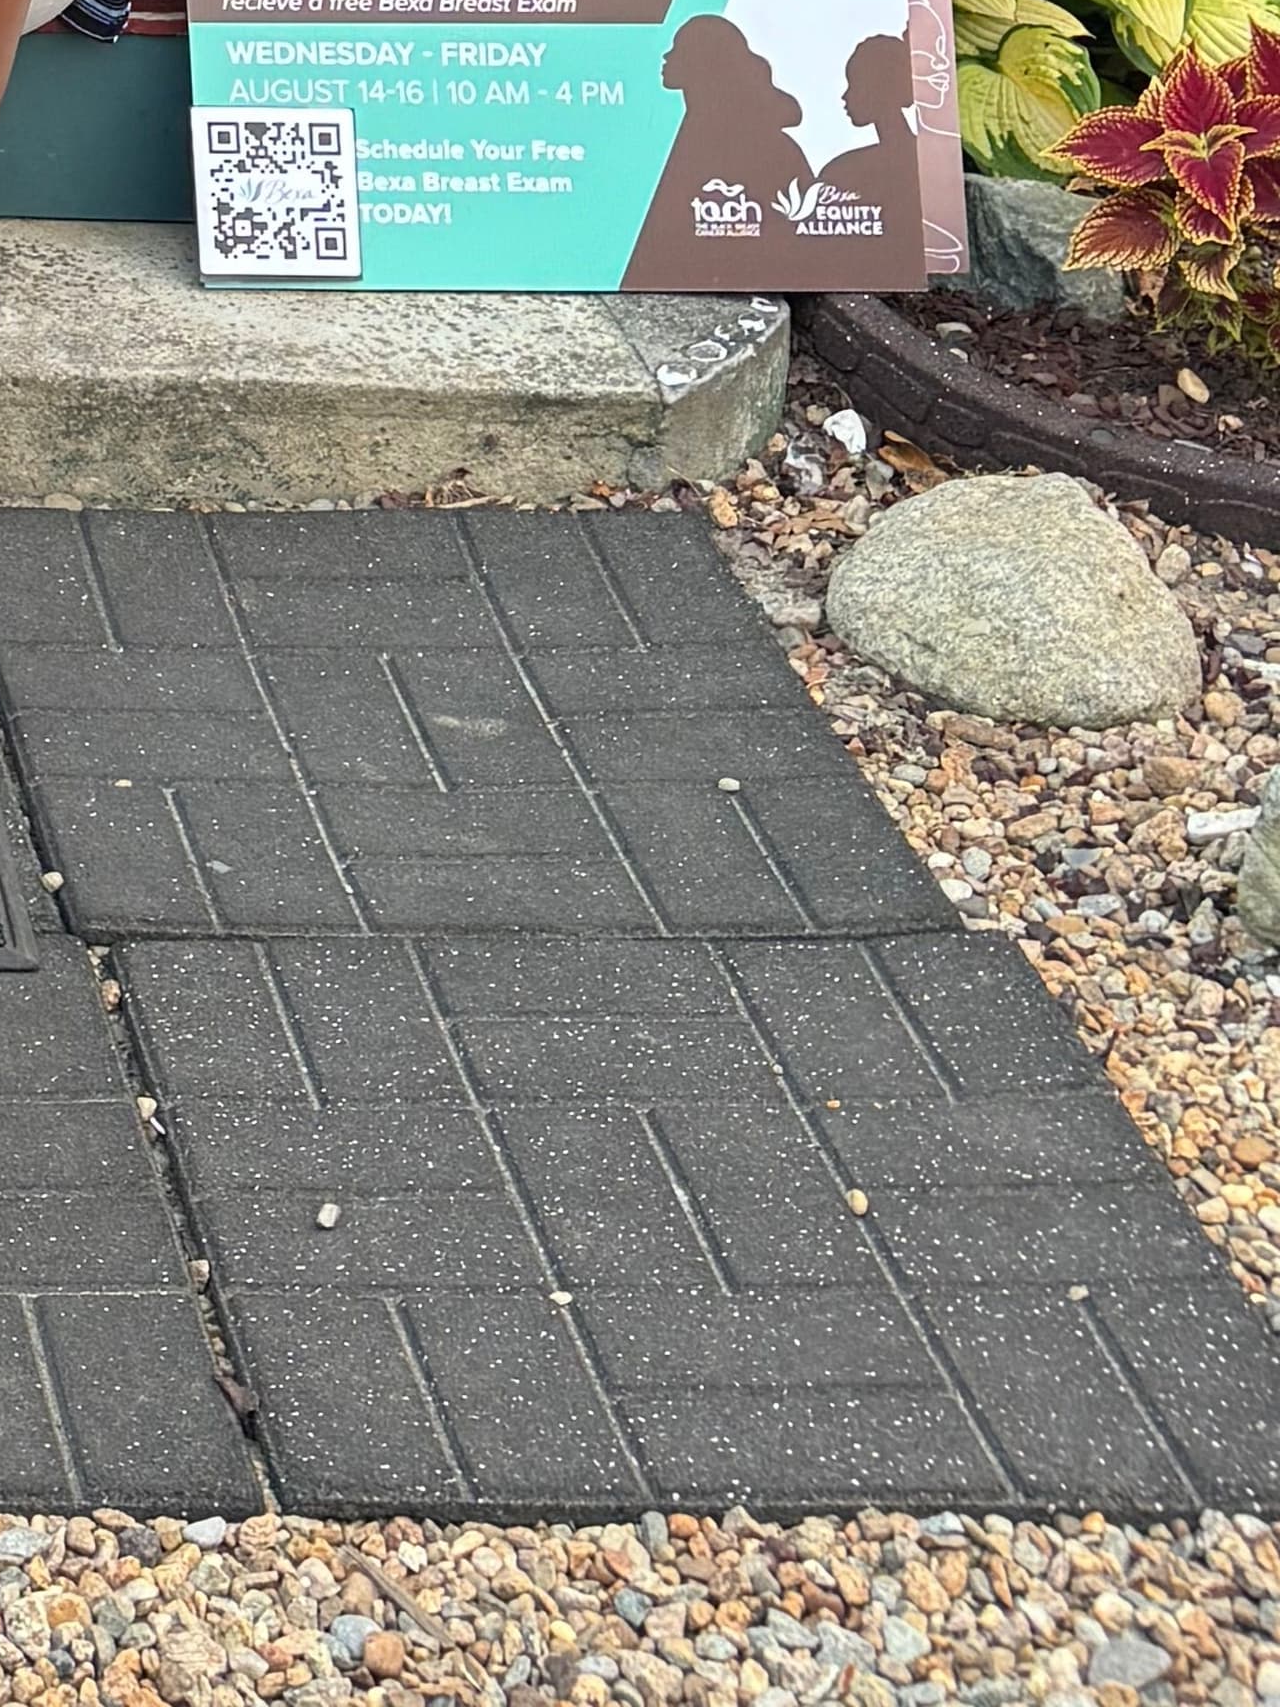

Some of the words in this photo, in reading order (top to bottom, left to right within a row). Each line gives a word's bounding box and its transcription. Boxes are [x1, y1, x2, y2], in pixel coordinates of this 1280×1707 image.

[226, 41, 414, 66] WEDNESDAY
[441, 43, 547, 67] FRIDAY
[228, 79, 350, 104] AUGUST
[358, 80, 424, 105] 14-16
[446, 80, 476, 104] 10
[485, 81, 530, 104] AM
[556, 81, 573, 104] 4
[581, 81, 624, 105] PM
[356, 139, 465, 161] Schedule
[470, 139, 524, 161] Your
[531, 140, 585, 161] Free
[359, 172, 416, 192] Bexa
[422, 172, 500, 192] Breast
[507, 172, 573, 193] Exam
[359, 203, 452, 225] TODAY!
[816, 206, 882, 221] EQUITY
[796, 221, 884, 236] ALLIANCE
